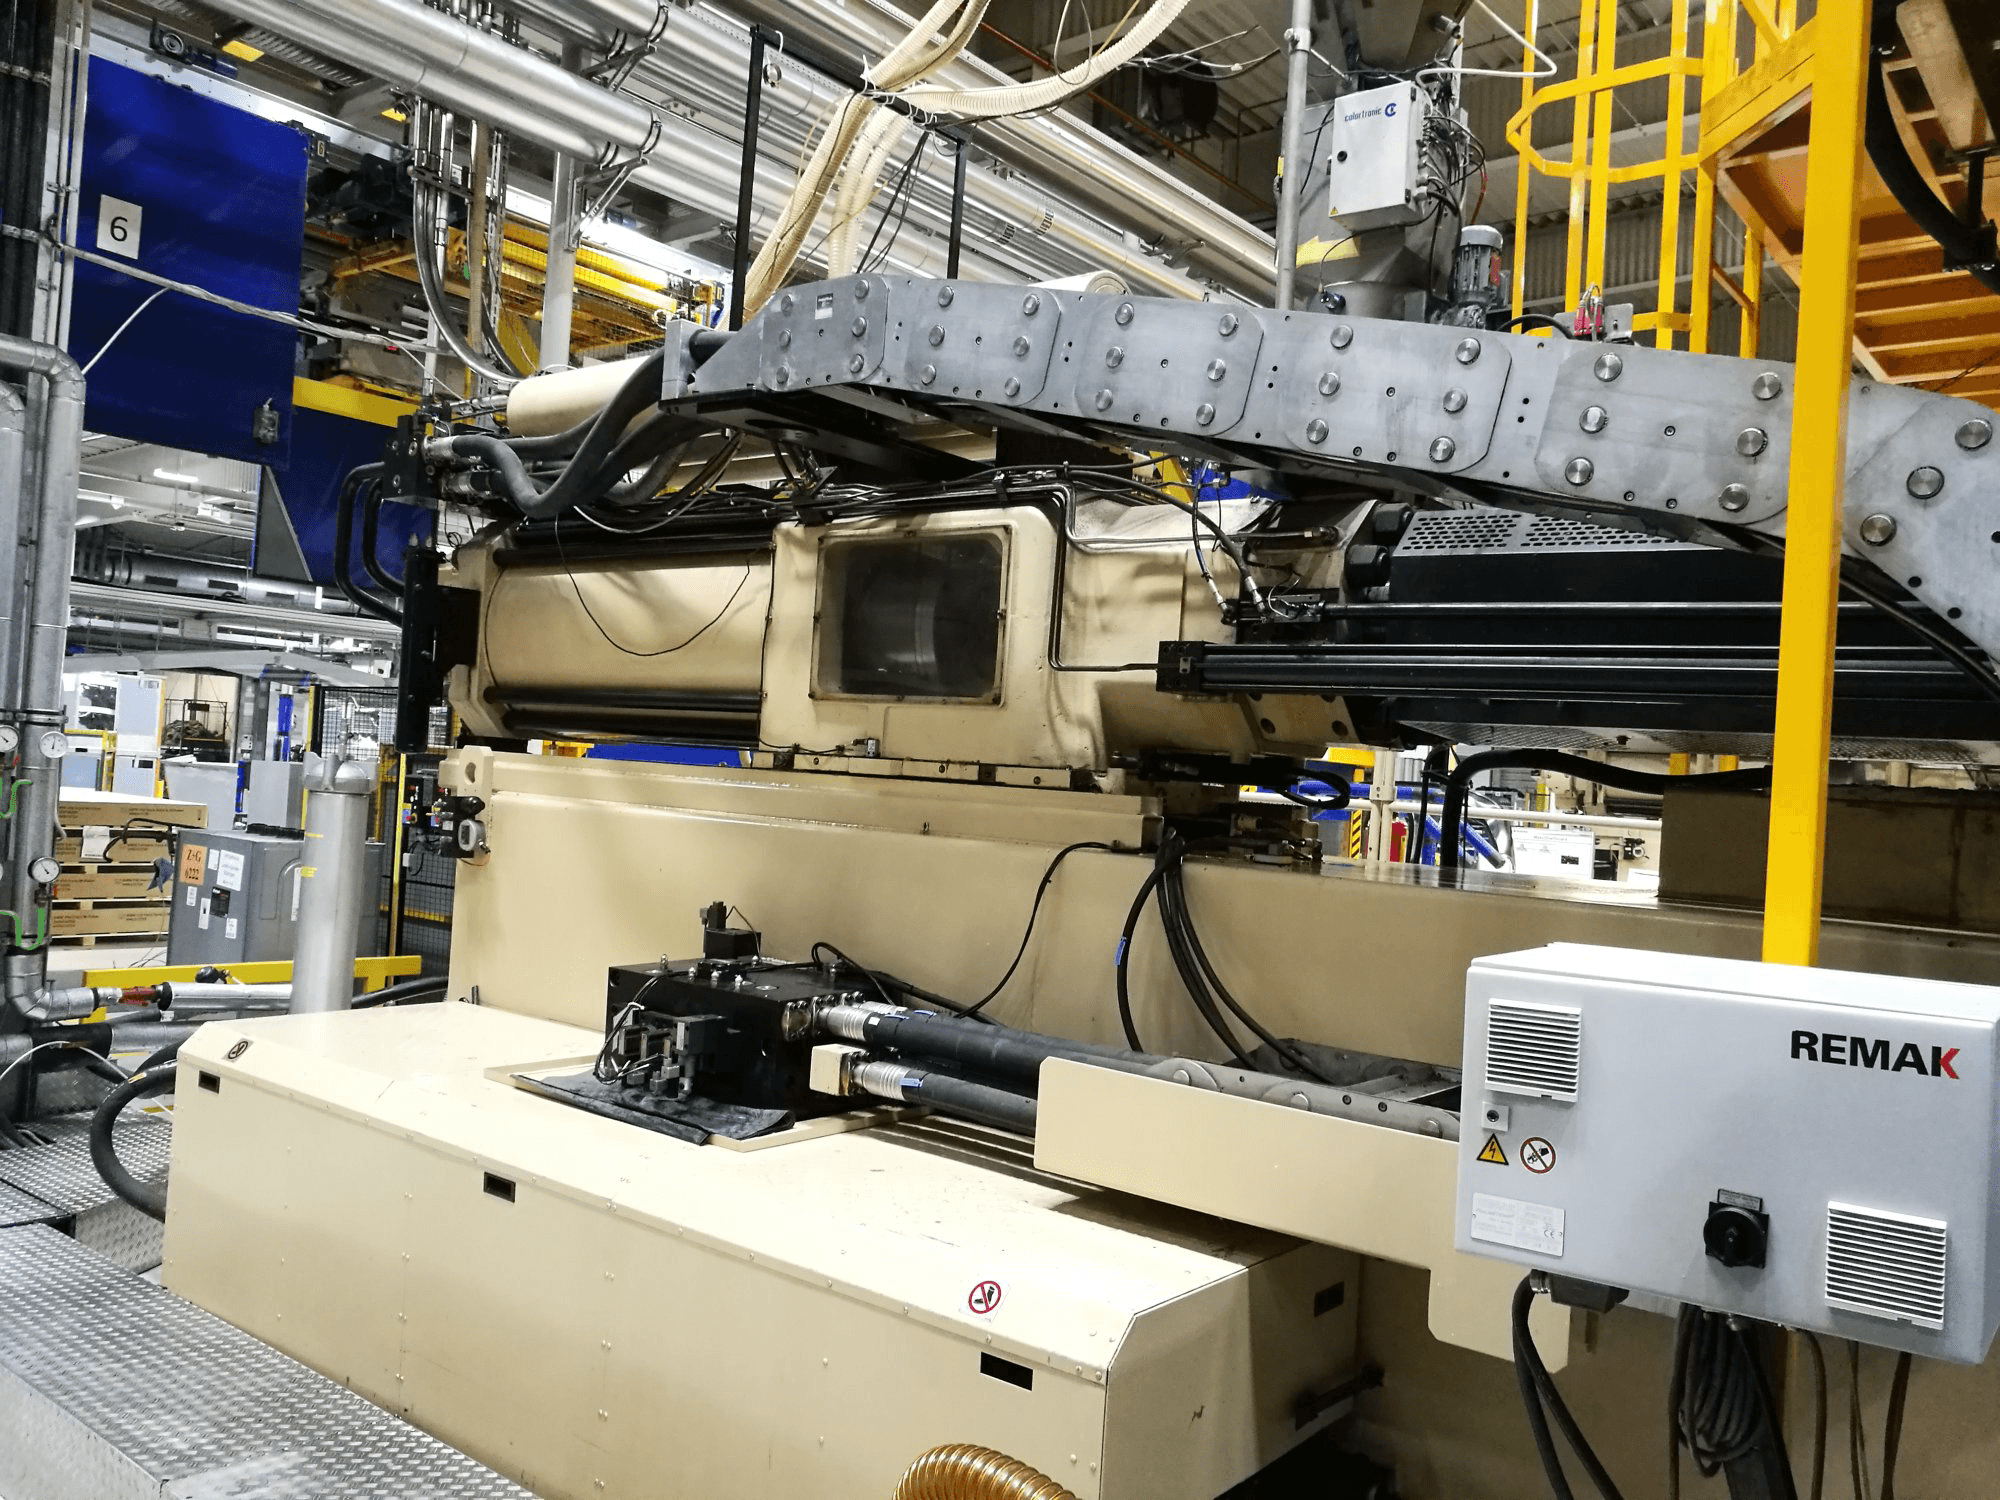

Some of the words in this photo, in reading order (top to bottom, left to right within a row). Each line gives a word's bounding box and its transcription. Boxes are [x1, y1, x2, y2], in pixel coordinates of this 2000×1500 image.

[1344, 107, 1382, 122] colortronic
[110, 216, 128, 242] 6
[1791, 1030, 1961, 1080] REMAK
